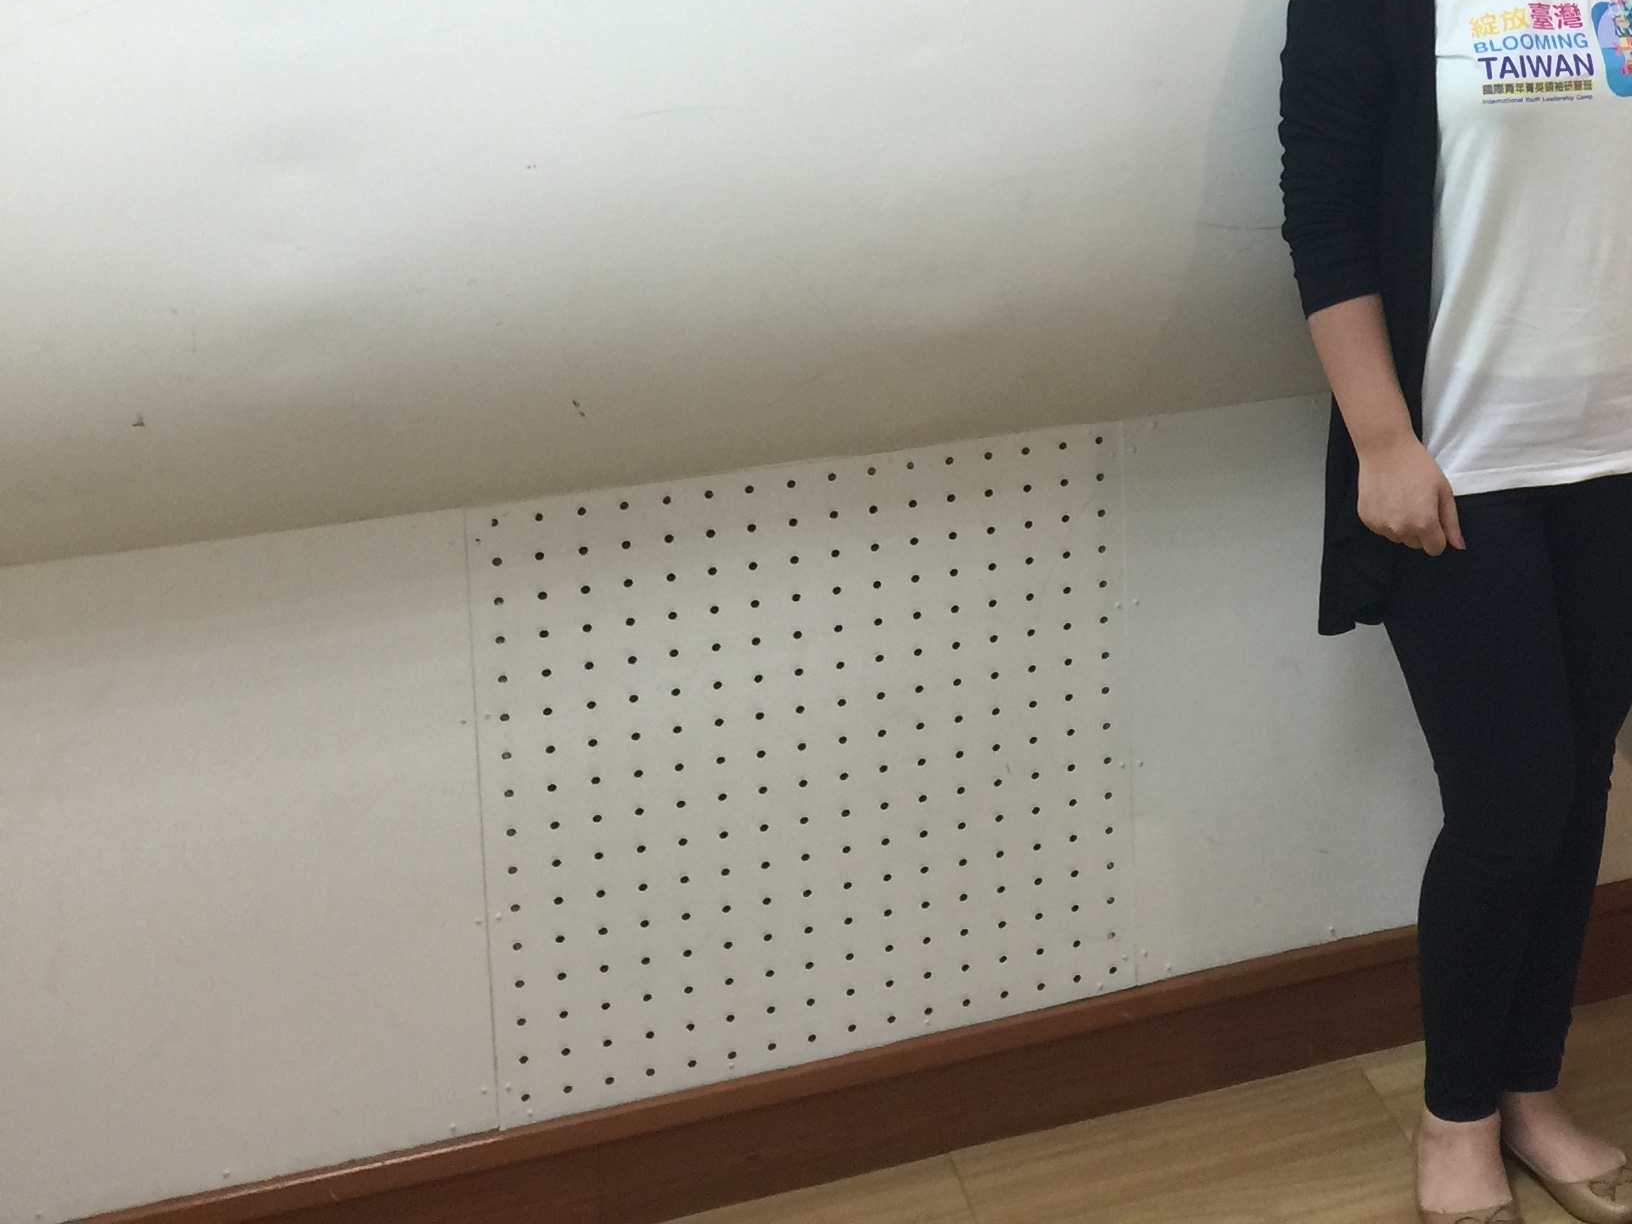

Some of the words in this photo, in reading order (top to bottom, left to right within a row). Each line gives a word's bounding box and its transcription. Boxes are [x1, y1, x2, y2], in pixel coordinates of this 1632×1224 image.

[1469, 2, 1584, 38] 綻放臺灣
[1474, 33, 1588, 53] BLOOMING
[1478, 53, 1595, 80] TAIWAN
